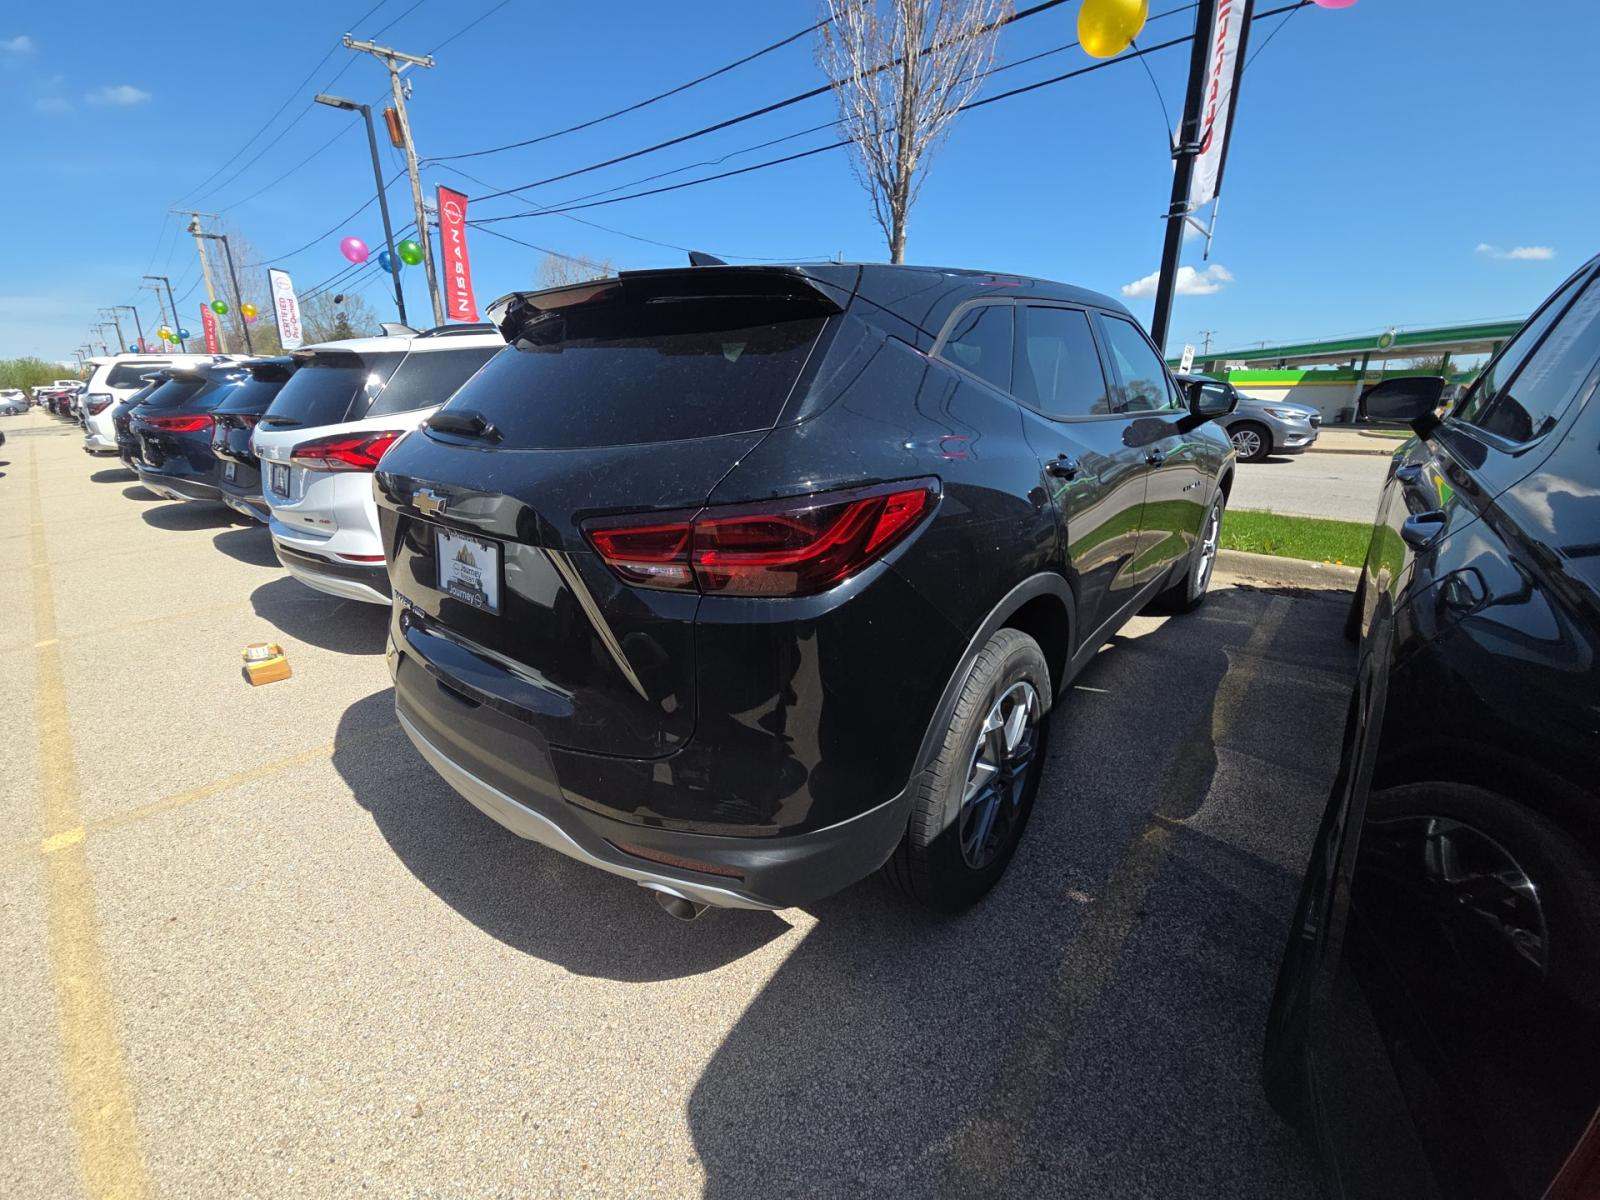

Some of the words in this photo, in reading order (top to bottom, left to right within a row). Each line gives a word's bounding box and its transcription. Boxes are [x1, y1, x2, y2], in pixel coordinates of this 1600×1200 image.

[451, 228, 470, 312] NISSAN
[278, 297, 292, 339] CERTIFIED
[287, 298, 300, 339] Pre-Owned
[449, 584, 475, 605] Journey
